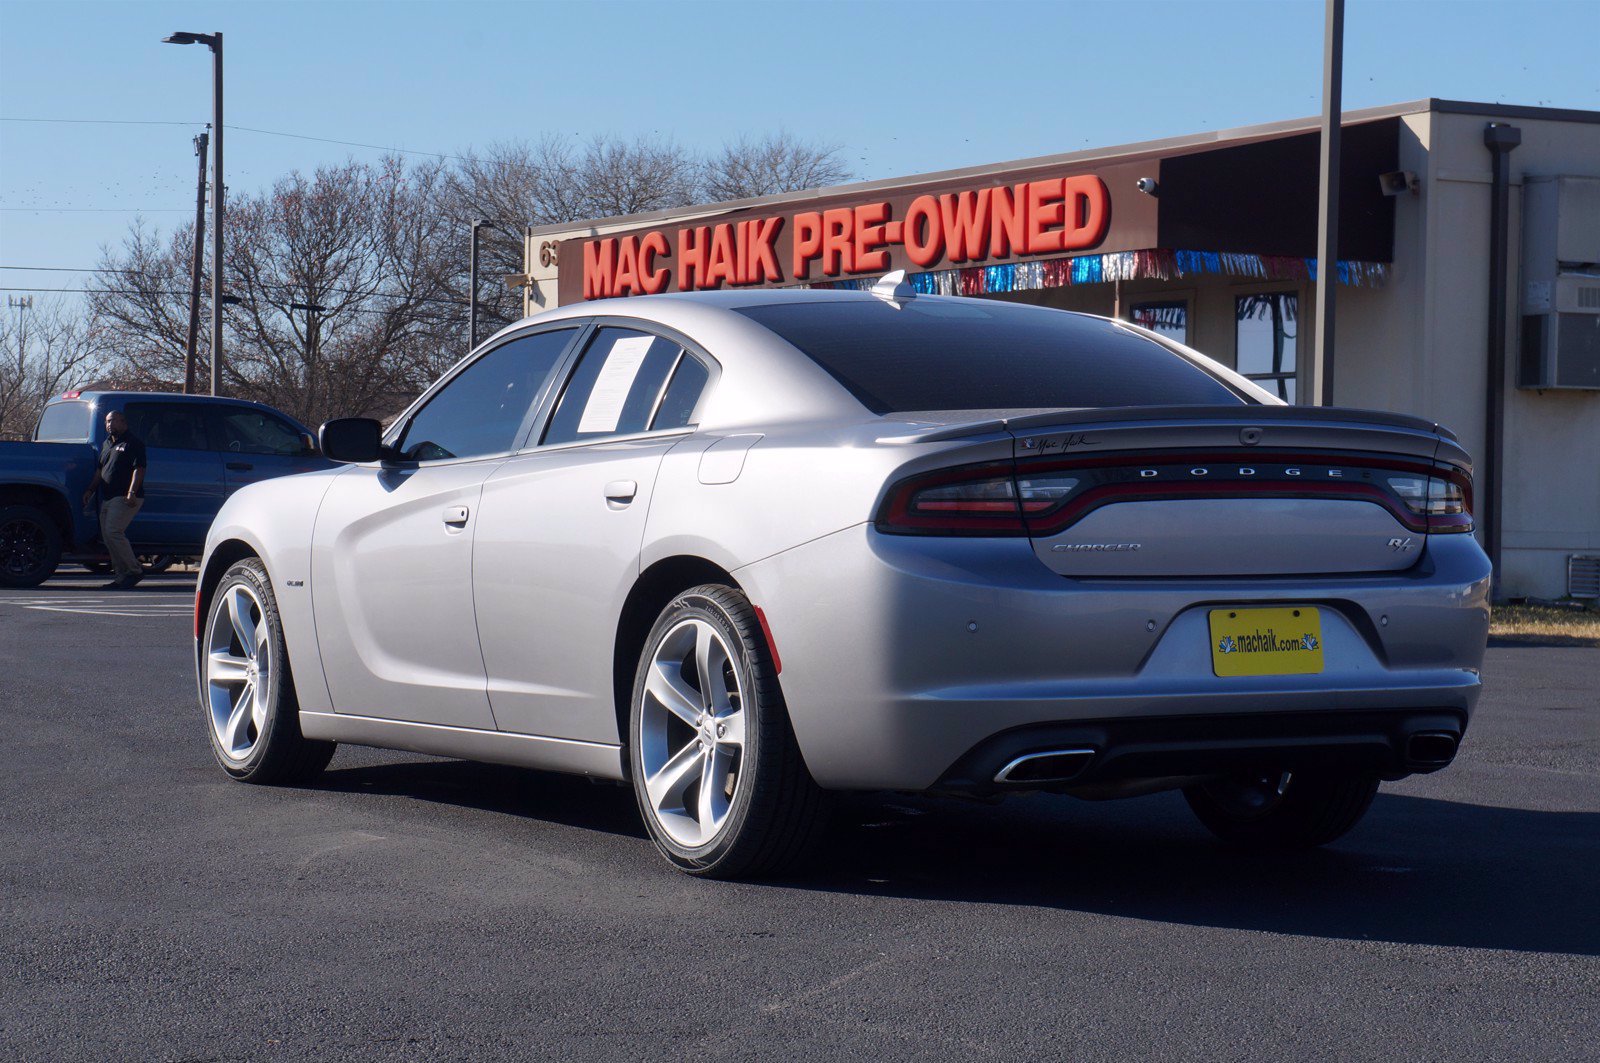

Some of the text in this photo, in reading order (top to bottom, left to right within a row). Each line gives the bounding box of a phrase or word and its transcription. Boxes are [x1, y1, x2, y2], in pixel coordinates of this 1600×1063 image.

[583, 174, 1112, 299] MAC HAIK PRE-OWNED
[540, 240, 560, 268] 63
[1140, 467, 1342, 478] DODGE
[1050, 543, 1141, 553] CHARGER
[1387, 537, 1416, 552] R/T
[1237, 628, 1301, 654] machaik.com
